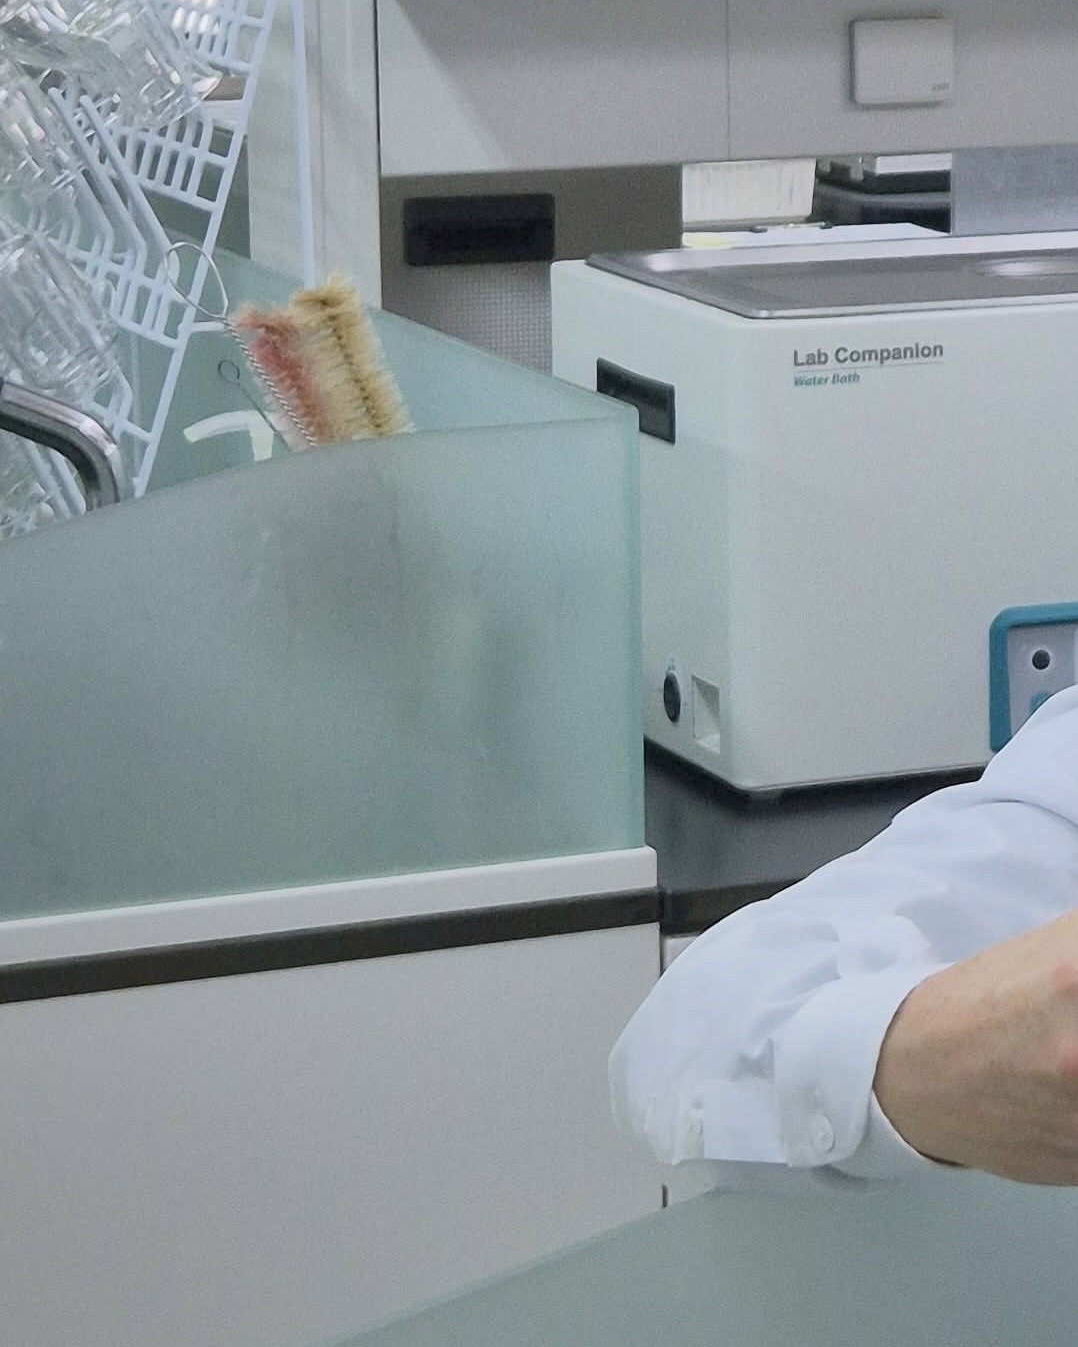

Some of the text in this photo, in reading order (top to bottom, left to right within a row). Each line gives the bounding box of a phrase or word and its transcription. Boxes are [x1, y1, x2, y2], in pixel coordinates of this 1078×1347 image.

[793, 342, 944, 367] Lab Companion
[793, 371, 861, 387] Water Bath
